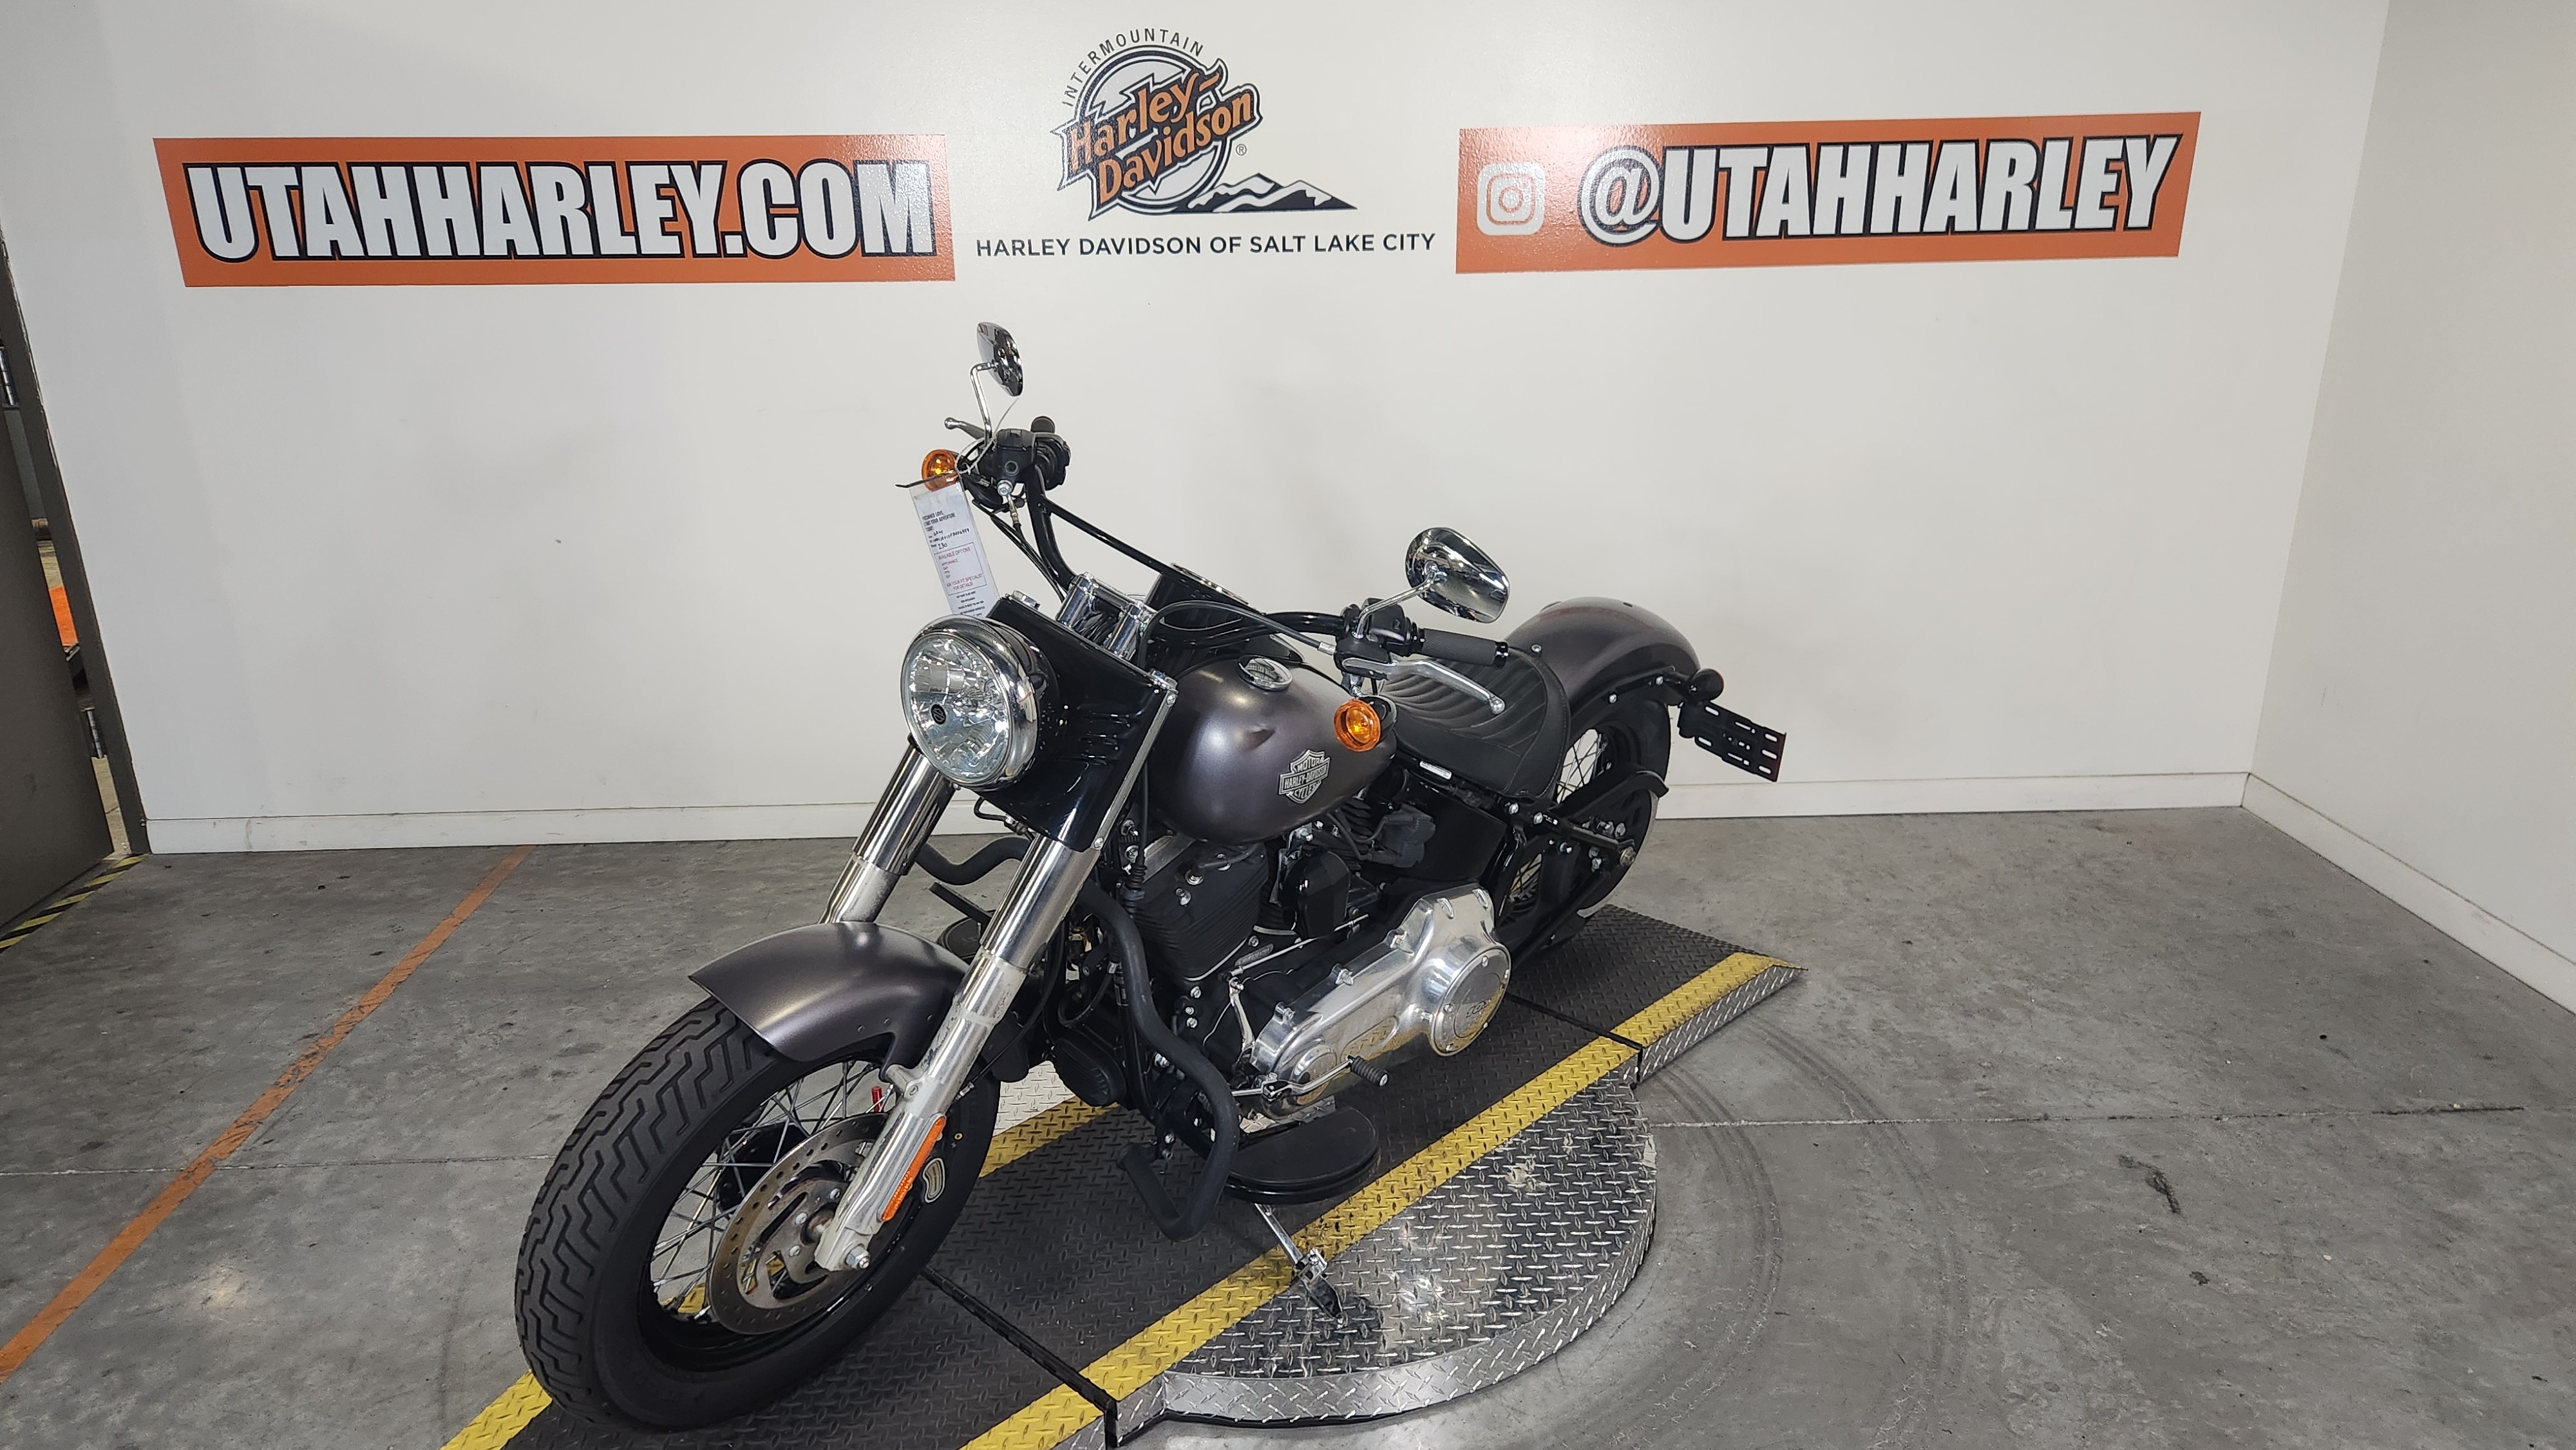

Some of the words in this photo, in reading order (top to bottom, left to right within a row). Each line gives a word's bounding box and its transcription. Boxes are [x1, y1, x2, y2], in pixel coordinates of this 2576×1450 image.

[1062, 27, 1204, 108] INTERMOUNTAIN
[1068, 71, 1221, 173] Harley-
[1097, 92, 1253, 205] Davidson
[183, 160, 937, 262] UTAHHARLEY.COM
[1577, 133, 2184, 247] @UTAHHARLEY
[976, 238, 1071, 256] HARLEY
[1079, 236, 1201, 256] DAVIDSON
[1209, 236, 1242, 254] OF
[1249, 235, 1306, 253] SALT
[1314, 234, 1375, 252] LAKE
[1383, 233, 1436, 251] CITY
[955, 547, 971, 555] OPTIONS
